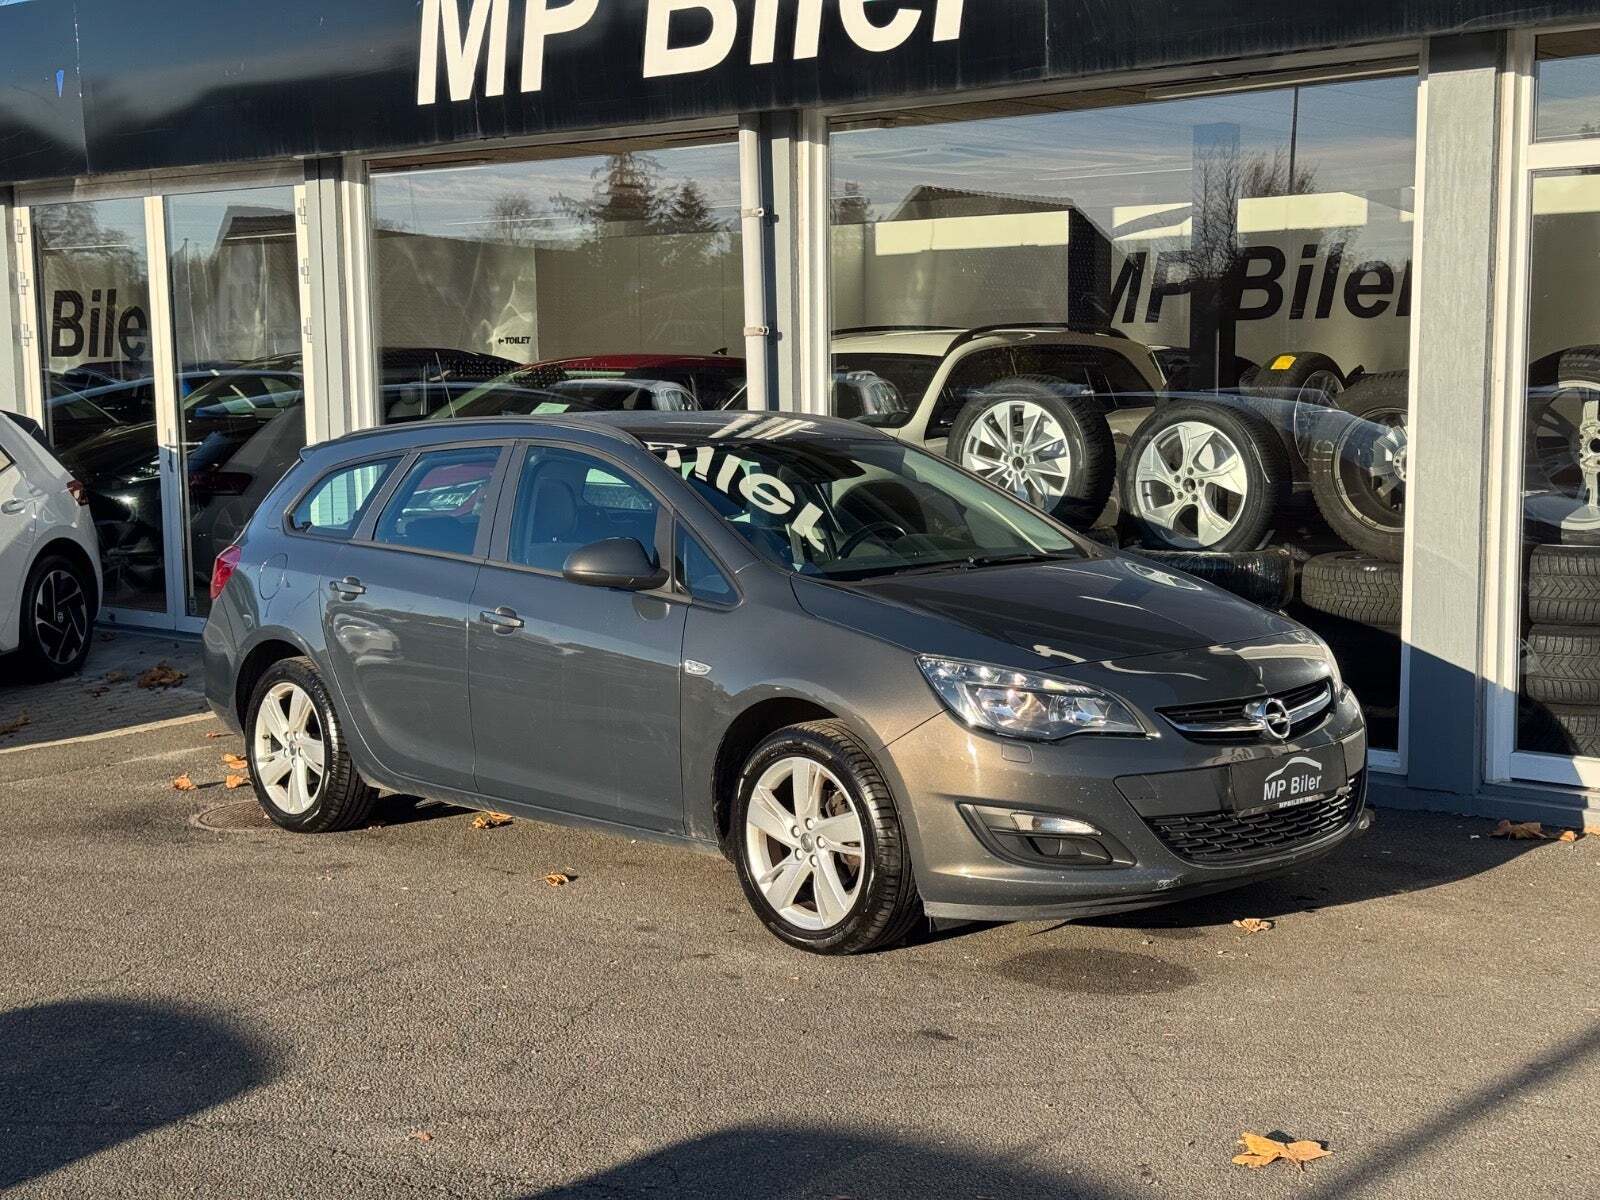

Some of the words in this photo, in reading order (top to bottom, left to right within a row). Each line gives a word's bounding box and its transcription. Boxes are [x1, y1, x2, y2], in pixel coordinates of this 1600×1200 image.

[417, 0, 600, 105] MP
[51, 288, 148, 359] Bile
[505, 336, 531, 345] TOILET
[1263, 780, 1287, 801] MP
[1290, 774, 1322, 795] Biler
